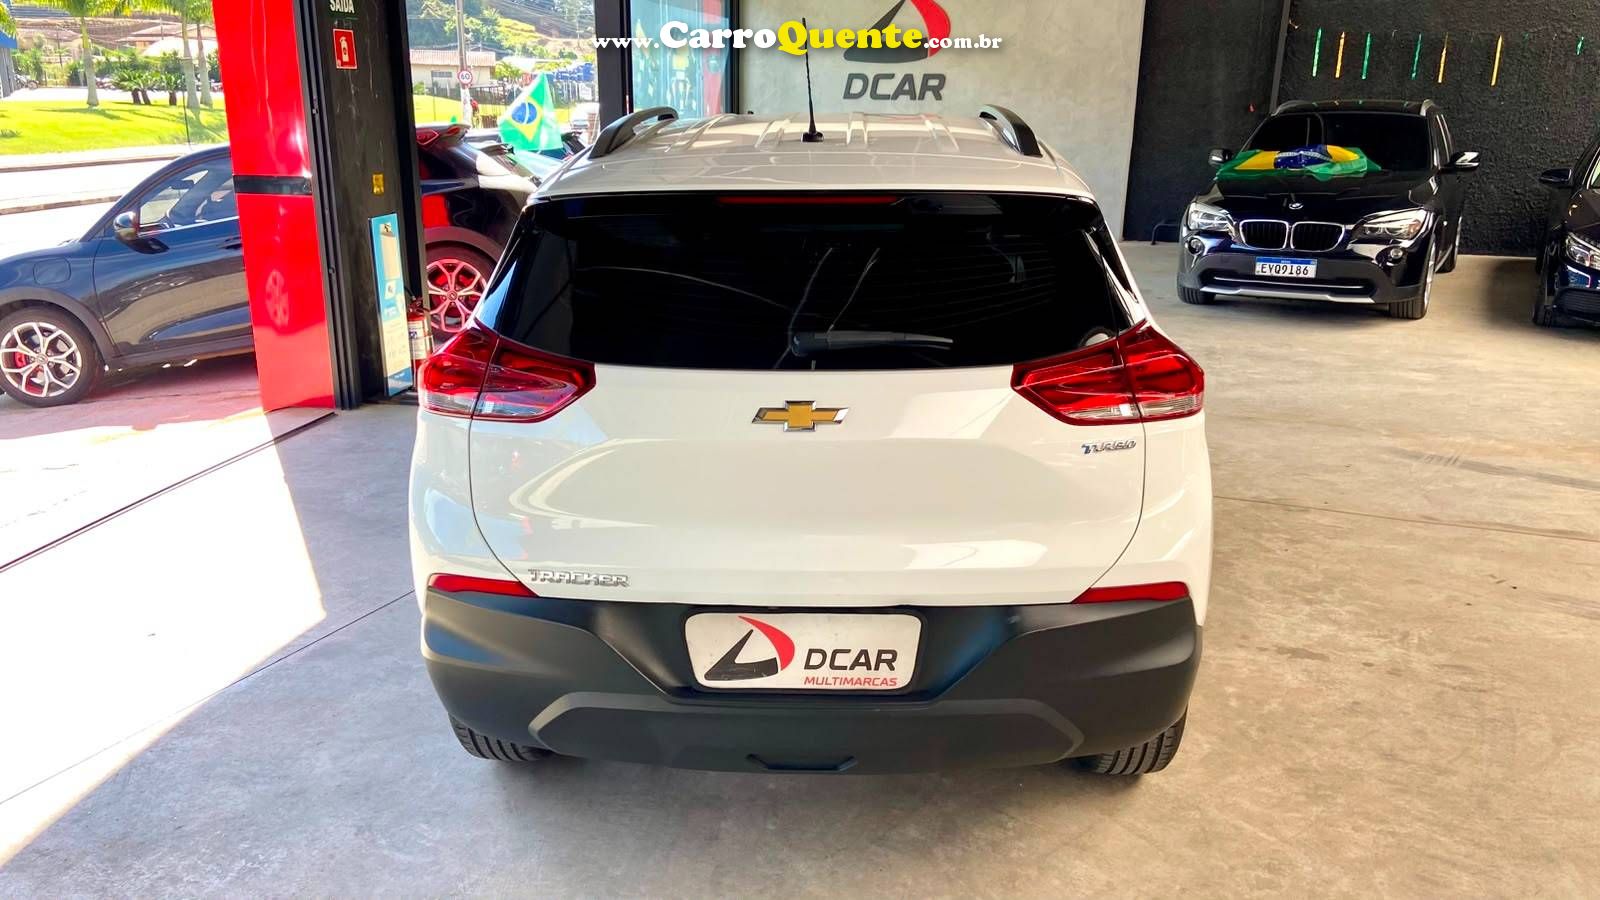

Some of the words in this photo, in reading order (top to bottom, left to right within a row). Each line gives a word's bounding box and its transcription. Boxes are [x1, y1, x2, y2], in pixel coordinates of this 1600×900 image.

[843, 73, 947, 101] DCAR
[527, 568, 630, 587] TRACKER
[803, 648, 898, 671] DCAR
[803, 676, 898, 687] MULTIMARCAS
